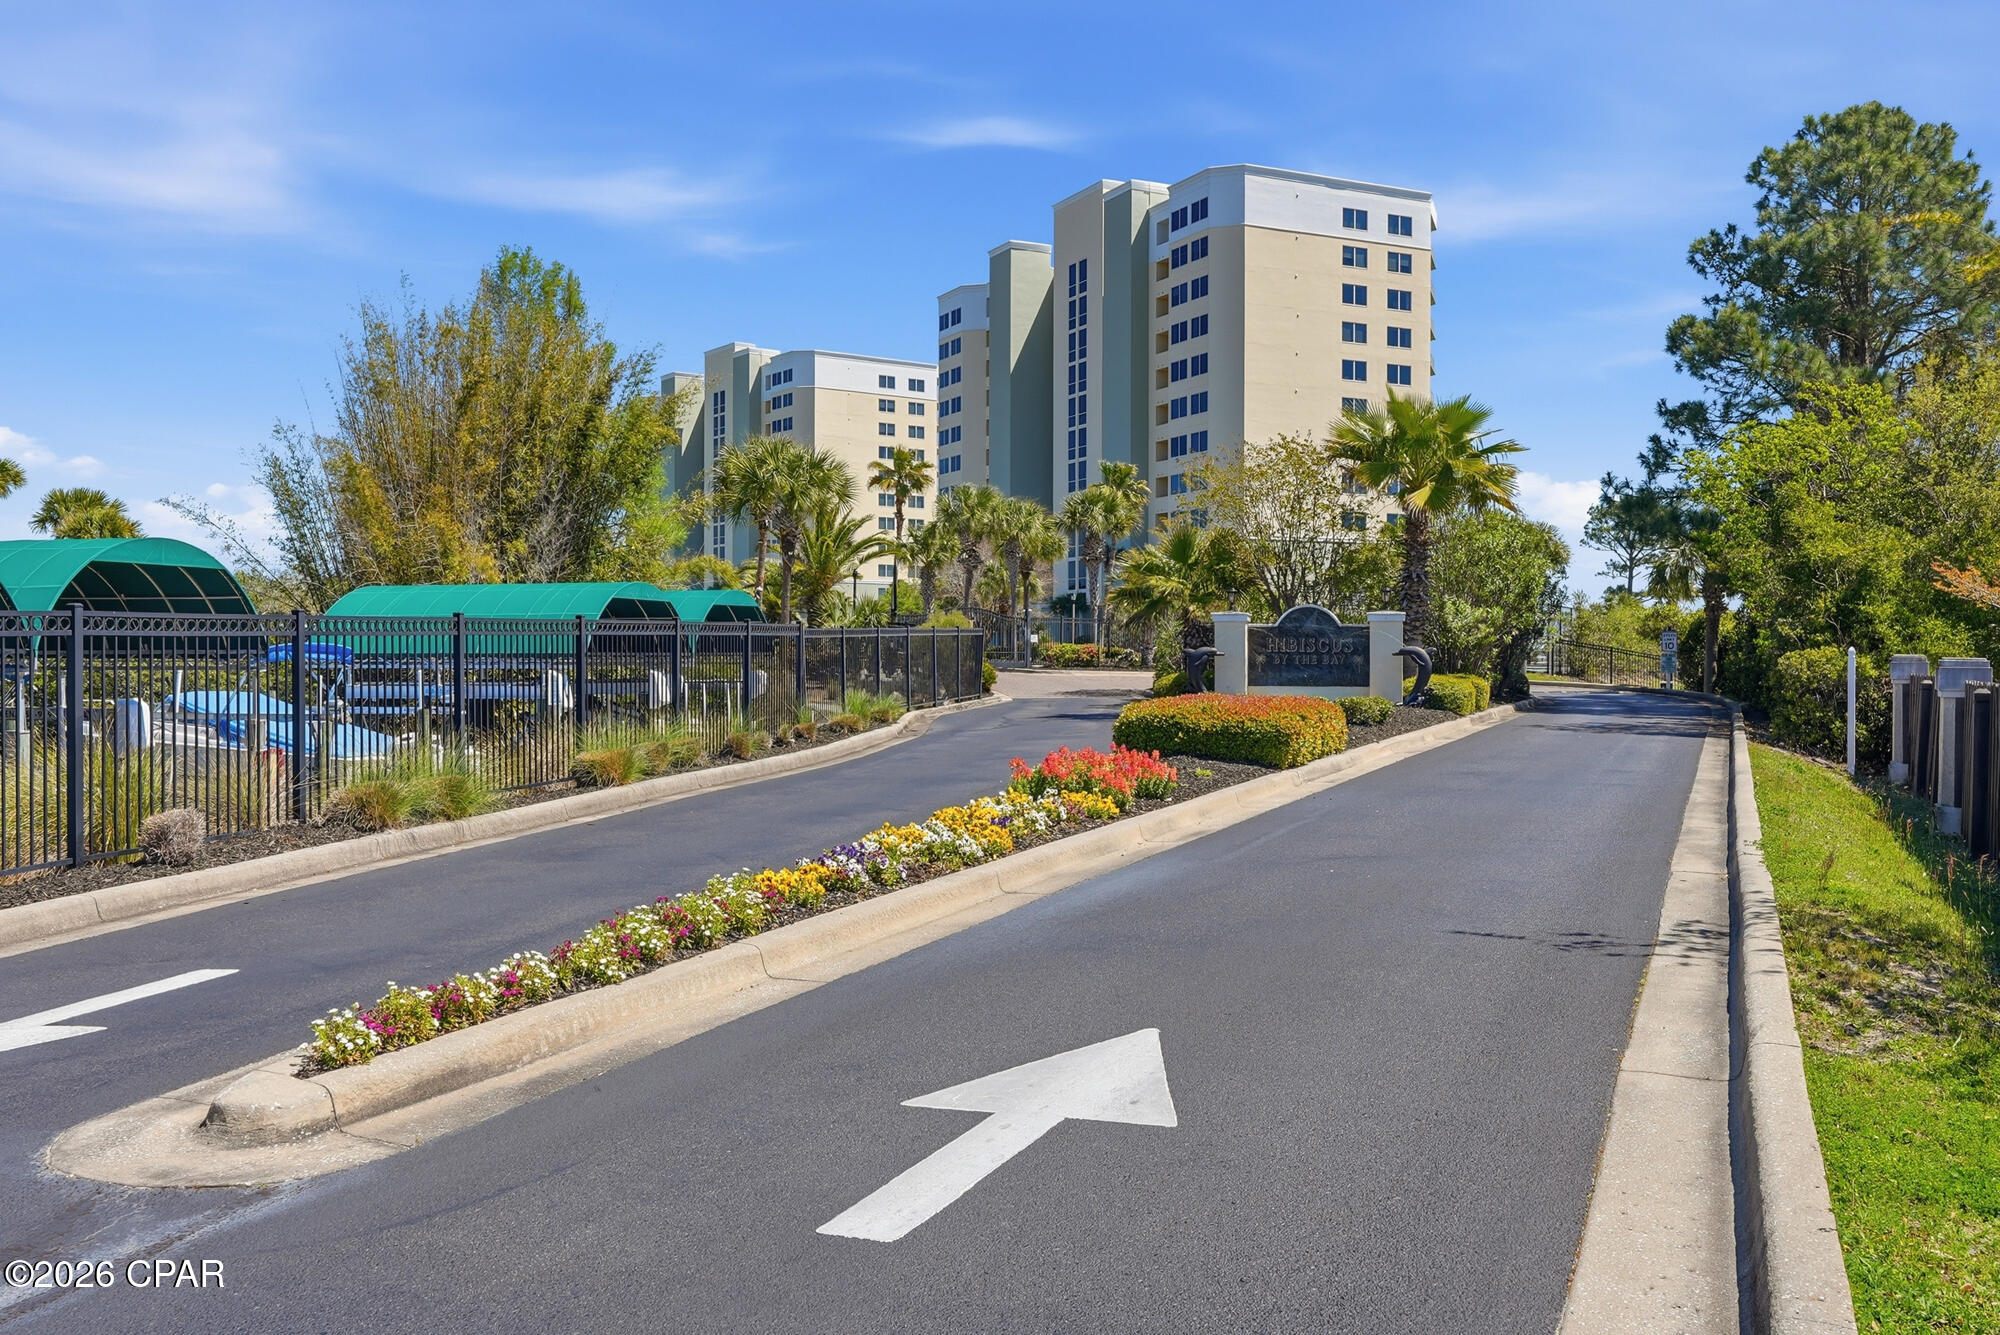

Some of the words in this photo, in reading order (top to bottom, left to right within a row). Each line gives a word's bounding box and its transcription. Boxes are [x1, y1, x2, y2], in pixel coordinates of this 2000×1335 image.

[1266, 637, 1354, 653] HIBISCUS
[1664, 642, 1674, 650] 10
[1272, 654, 1288, 665] BY
[1294, 654, 1318, 665] THE
[1321, 654, 1346, 665] BAY
